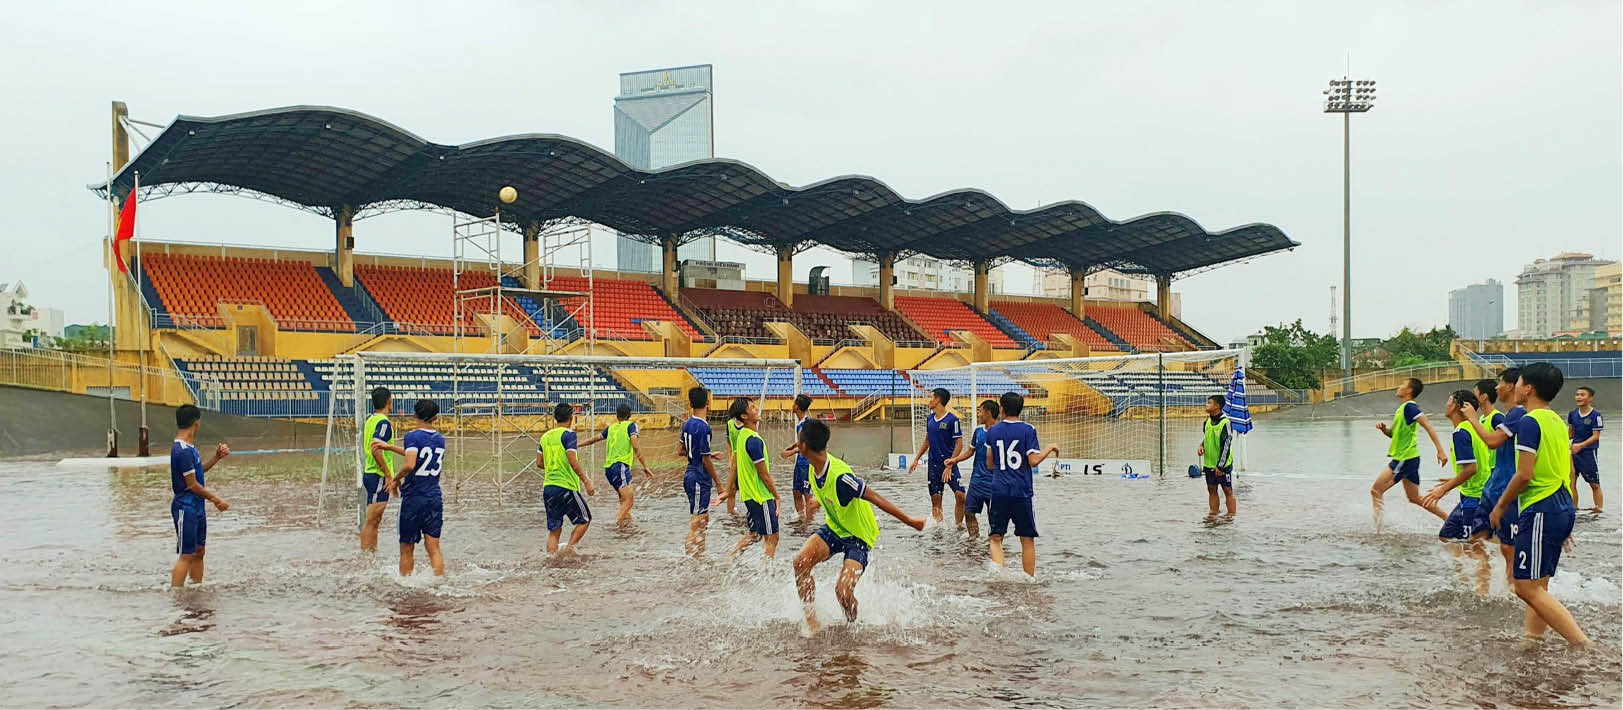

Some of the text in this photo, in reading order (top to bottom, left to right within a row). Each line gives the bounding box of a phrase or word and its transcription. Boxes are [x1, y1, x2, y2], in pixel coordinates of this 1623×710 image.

[415, 446, 446, 477] 23
[996, 439, 1022, 471] 16
[1060, 463, 1071, 471] PTI
[1462, 525, 1473, 538] 31
[1518, 550, 1527, 570] 2
